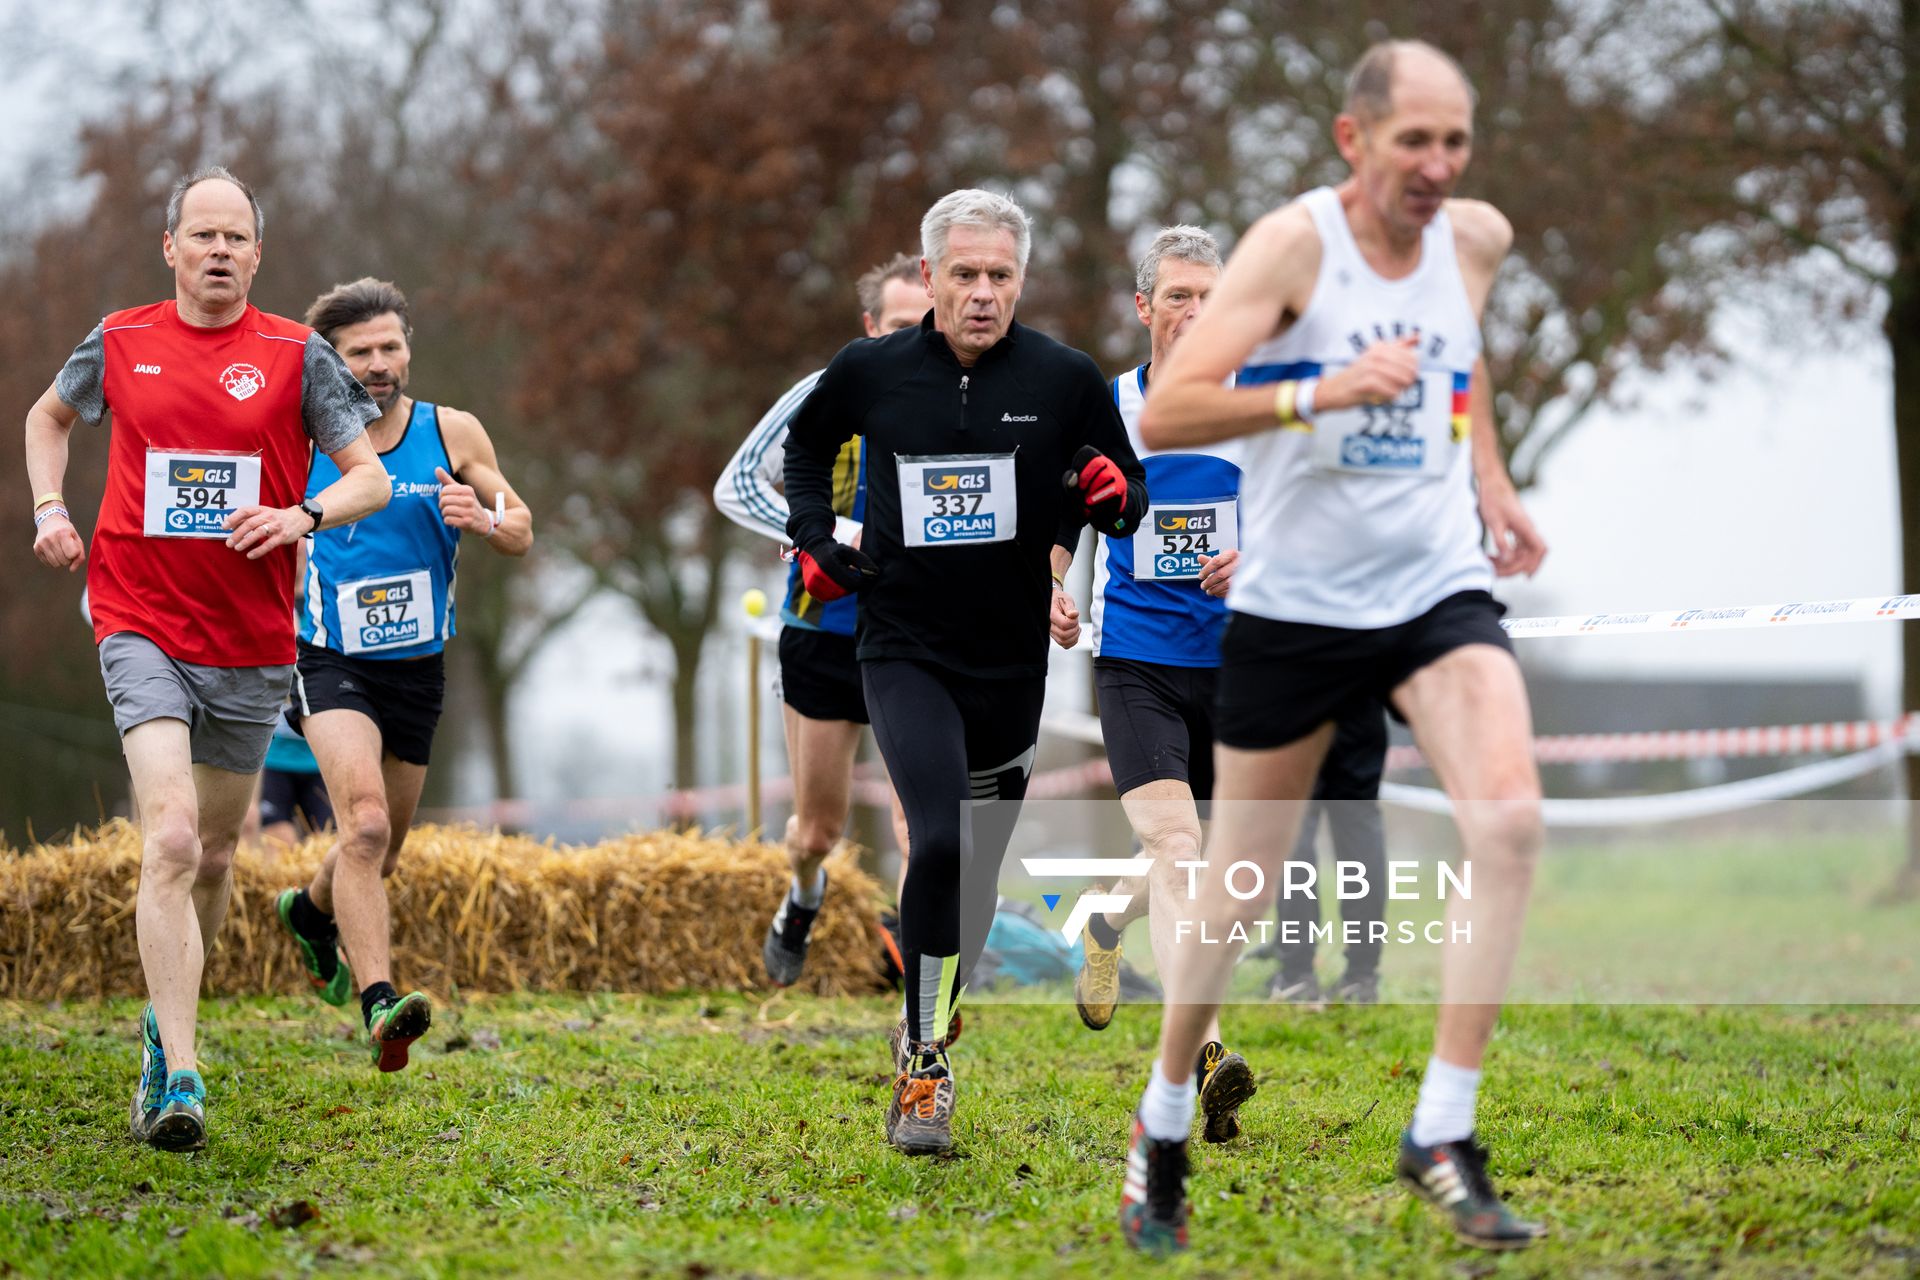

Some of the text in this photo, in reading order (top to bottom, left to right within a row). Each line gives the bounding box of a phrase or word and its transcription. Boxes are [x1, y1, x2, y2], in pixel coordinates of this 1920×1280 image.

[133, 364, 161, 375] JAKO
[204, 469, 231, 484] GLS
[958, 473, 985, 489] GLS
[175, 488, 228, 510] 594
[932, 494, 983, 517] 337
[953, 518, 992, 531] PLAN
[1187, 516, 1211, 529] GLS
[1162, 533, 1210, 554] 524
[387, 586, 408, 602] GLS
[366, 603, 408, 626] 617
[385, 622, 416, 638] PLAN
